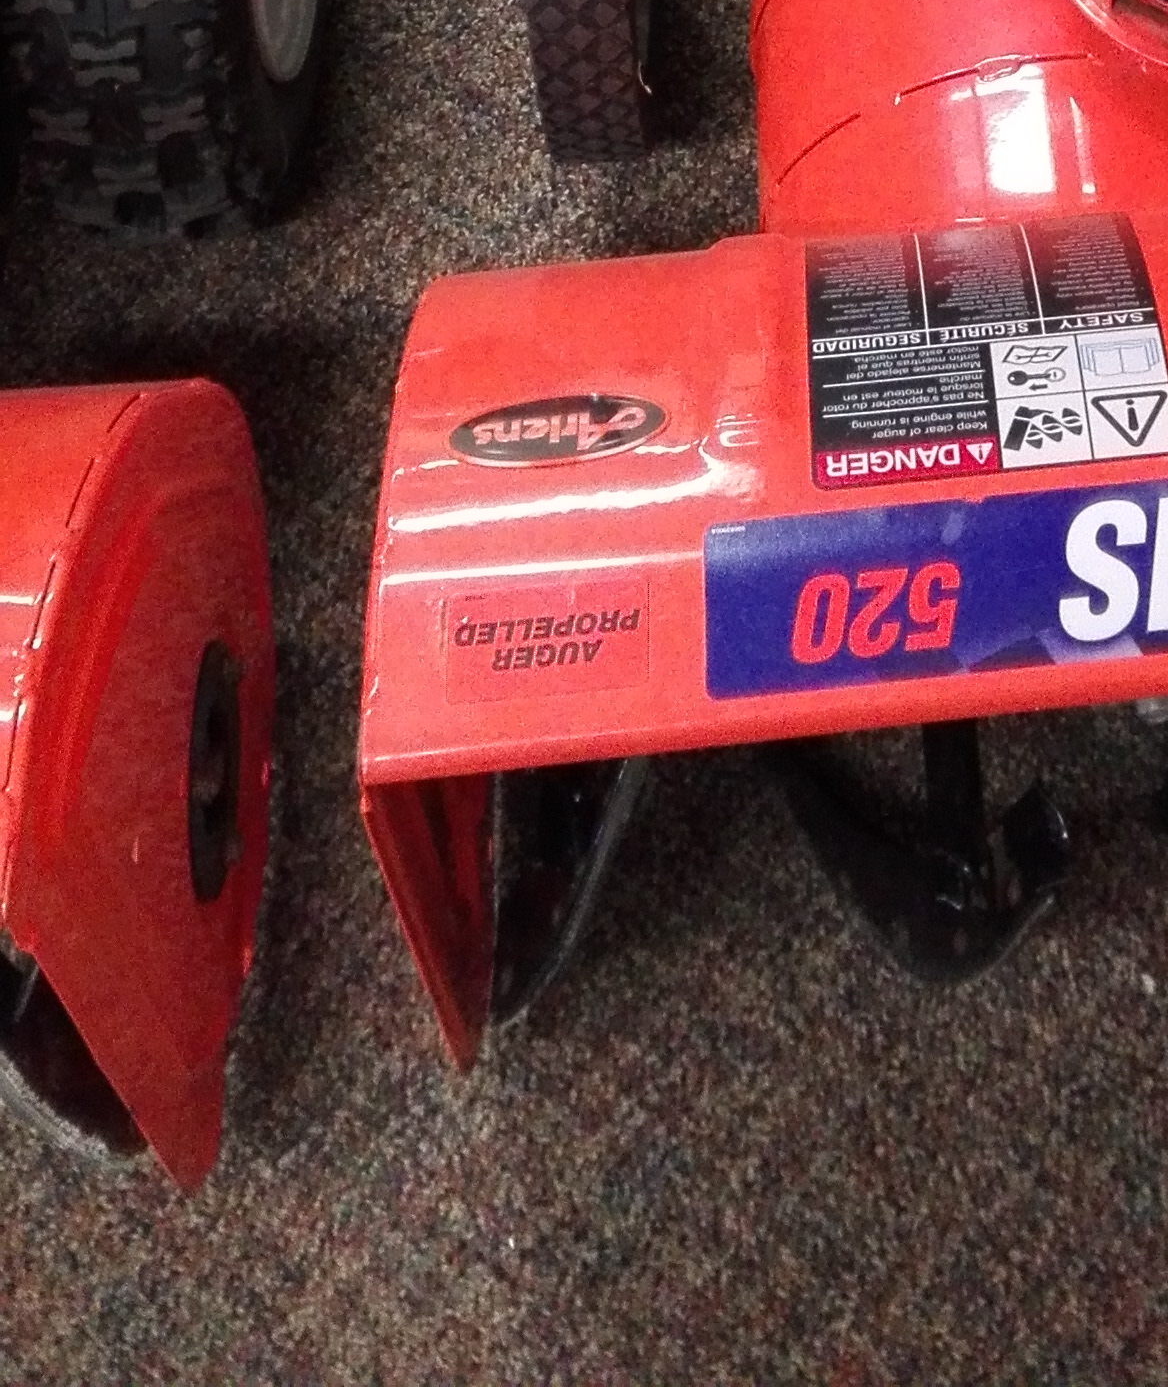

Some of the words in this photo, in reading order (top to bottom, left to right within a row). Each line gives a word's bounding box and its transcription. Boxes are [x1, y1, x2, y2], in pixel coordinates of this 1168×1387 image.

[1059, 312, 1144, 330] SAFETY
[939, 322, 1029, 343] SÉCURITÉ
[812, 332, 921, 353] SEGURIDAD
[946, 345, 979, 354] motor
[901, 351, 915, 359] en
[871, 360, 894, 369] que
[896, 356, 946, 367] mientras
[913, 360, 981, 373] Mantenerse
[857, 363, 868, 371] el
[846, 372, 864, 380] del
[867, 367, 909, 378] alejado
[927, 386, 937, 395] le
[940, 382, 984, 392] lorsque
[842, 394, 858, 402] en
[861, 391, 879, 400] est
[882, 388, 923, 398] moteur
[943, 392, 964, 402] pas
[967, 391, 985, 399] Ne
[822, 404, 850, 412] rotor
[852, 402, 868, 410] du
[913, 412, 953, 423] engine
[956, 410, 987, 420] while
[900, 417, 909, 425] is
[957, 421, 988, 431] Keep
[472, 406, 647, 451] Ariens
[872, 428, 906, 439] auger
[910, 427, 921, 436] of
[924, 424, 954, 434] clear
[826, 443, 961, 477] DANGER
[790, 561, 961, 665] 520
[454, 609, 641, 647] PROPELLED
[492, 639, 603, 672] AUGER
